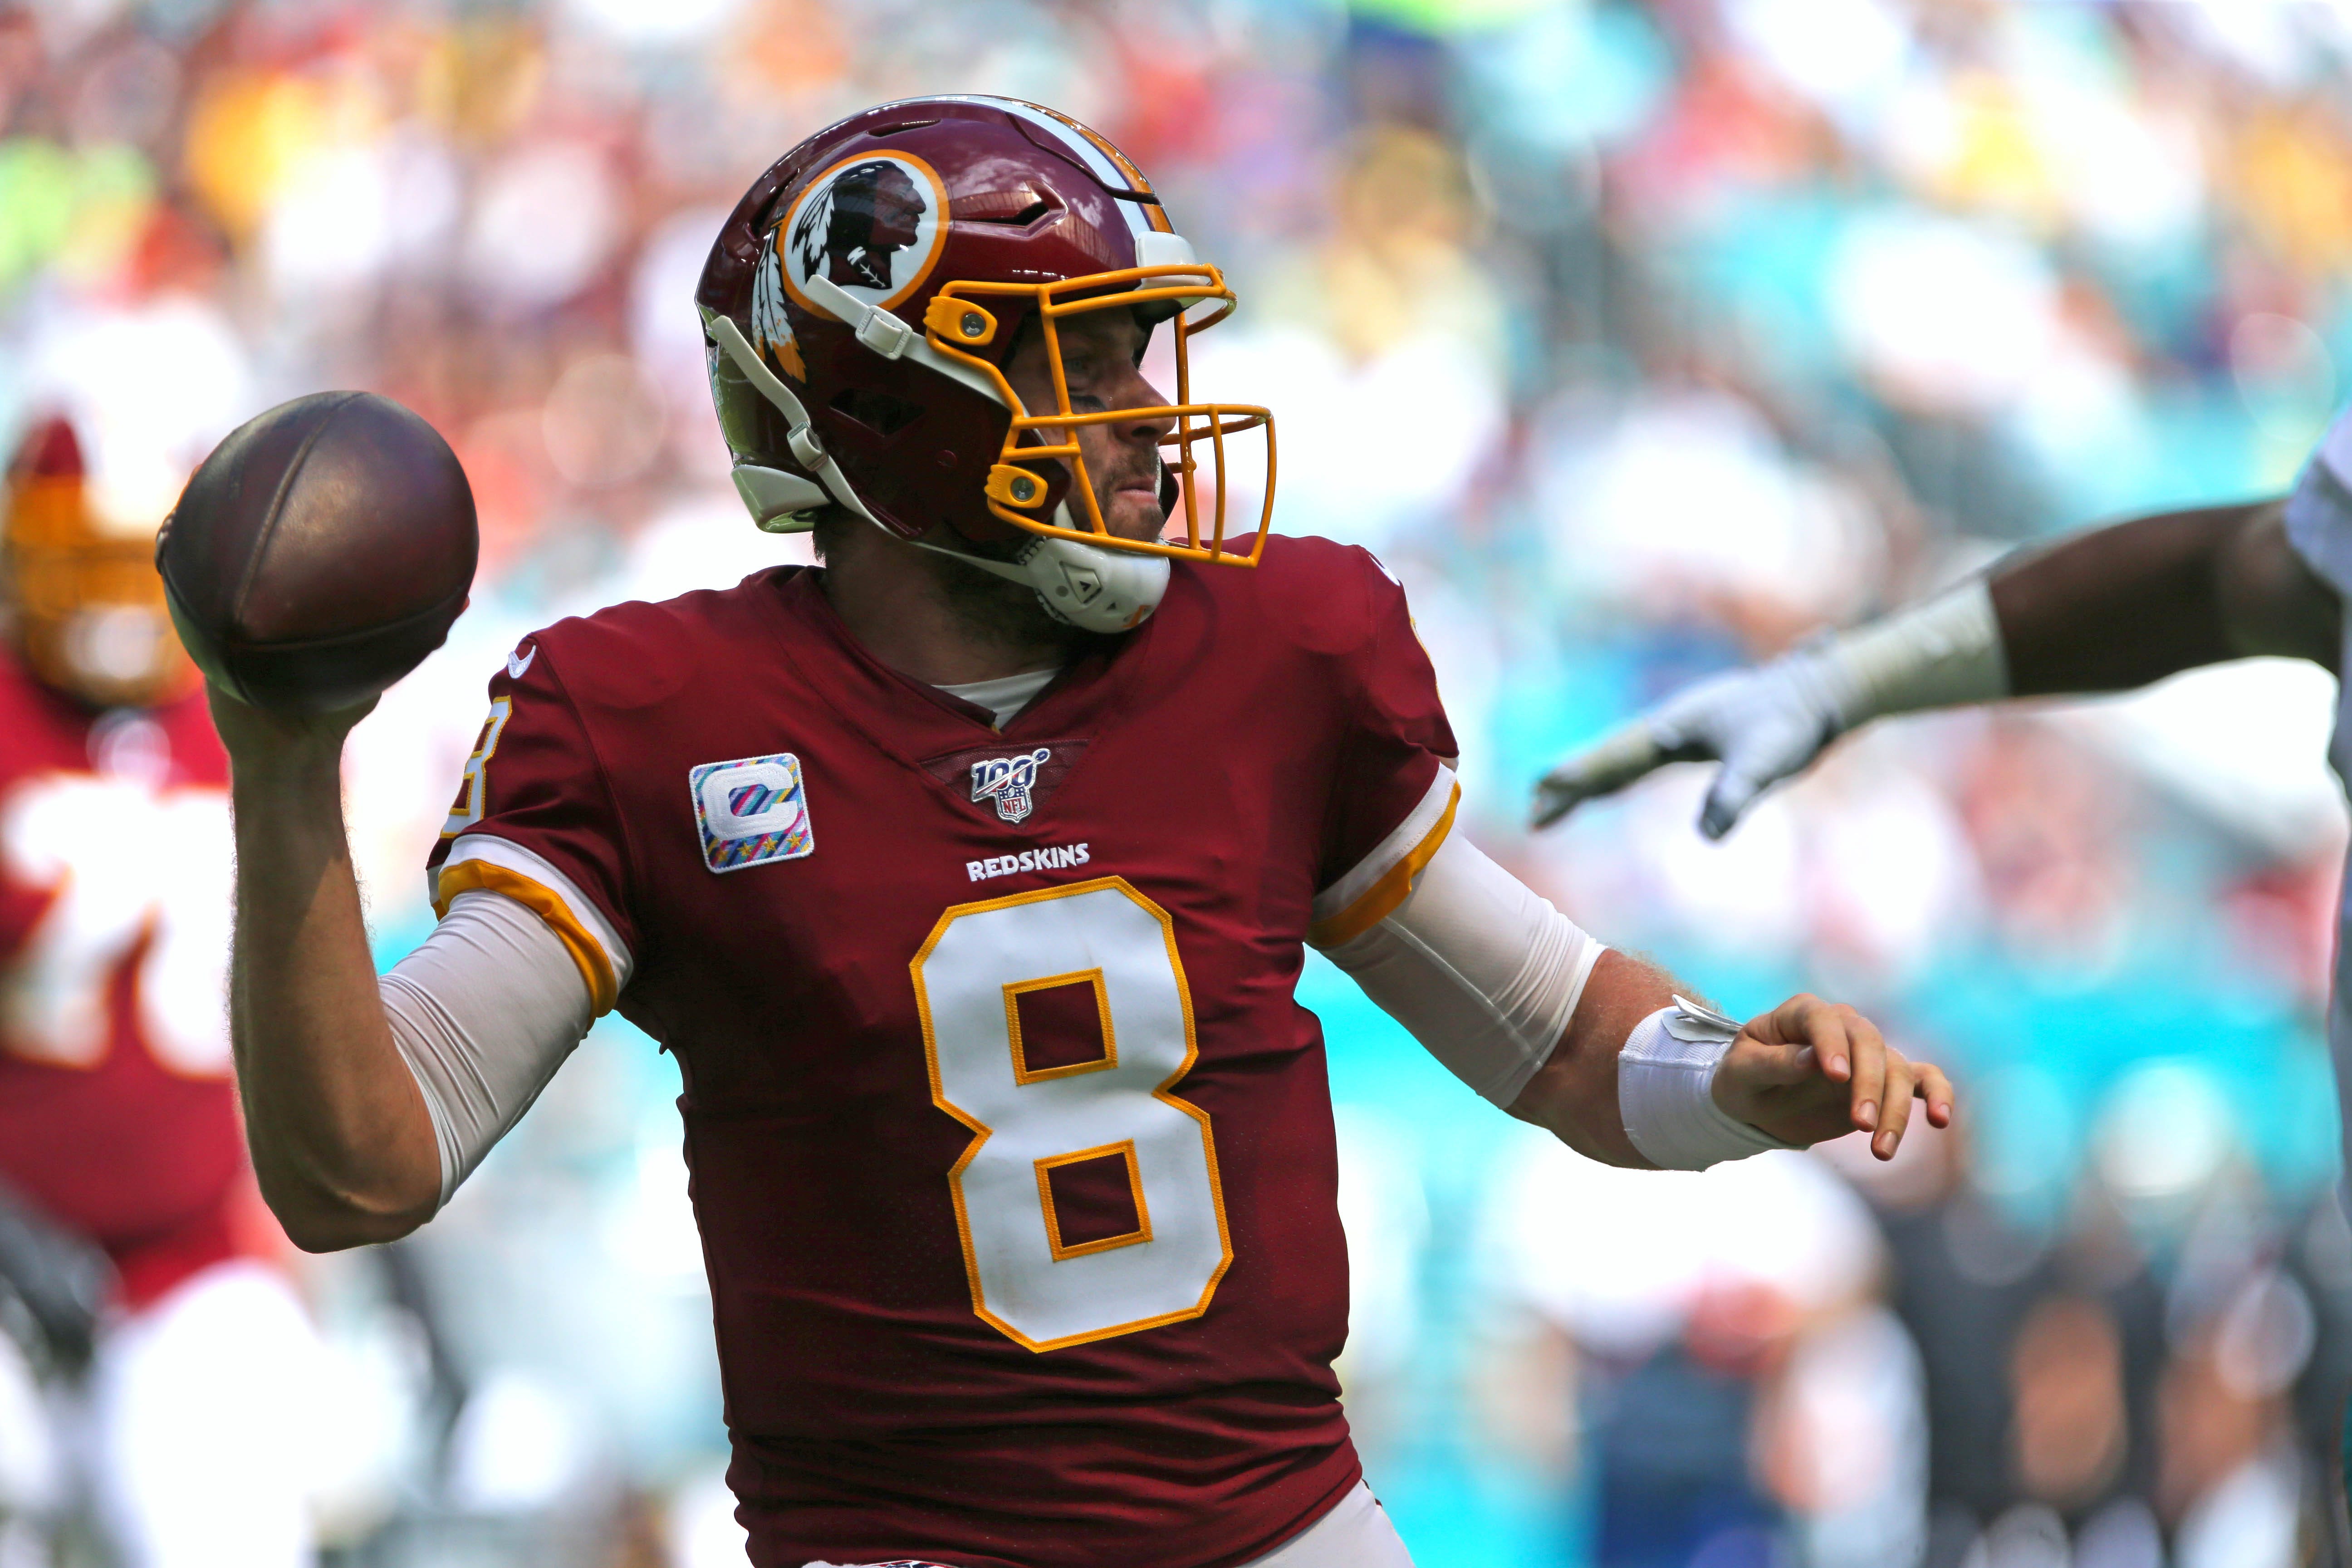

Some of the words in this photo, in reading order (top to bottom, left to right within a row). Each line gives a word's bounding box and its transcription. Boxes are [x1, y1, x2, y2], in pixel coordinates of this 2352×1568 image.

[974, 757, 1034, 792] 100
[702, 762, 798, 841] C
[1002, 797, 1027, 814] NFL
[965, 843, 1090, 882] REDSKINS
[909, 875, 1234, 1353] 8
